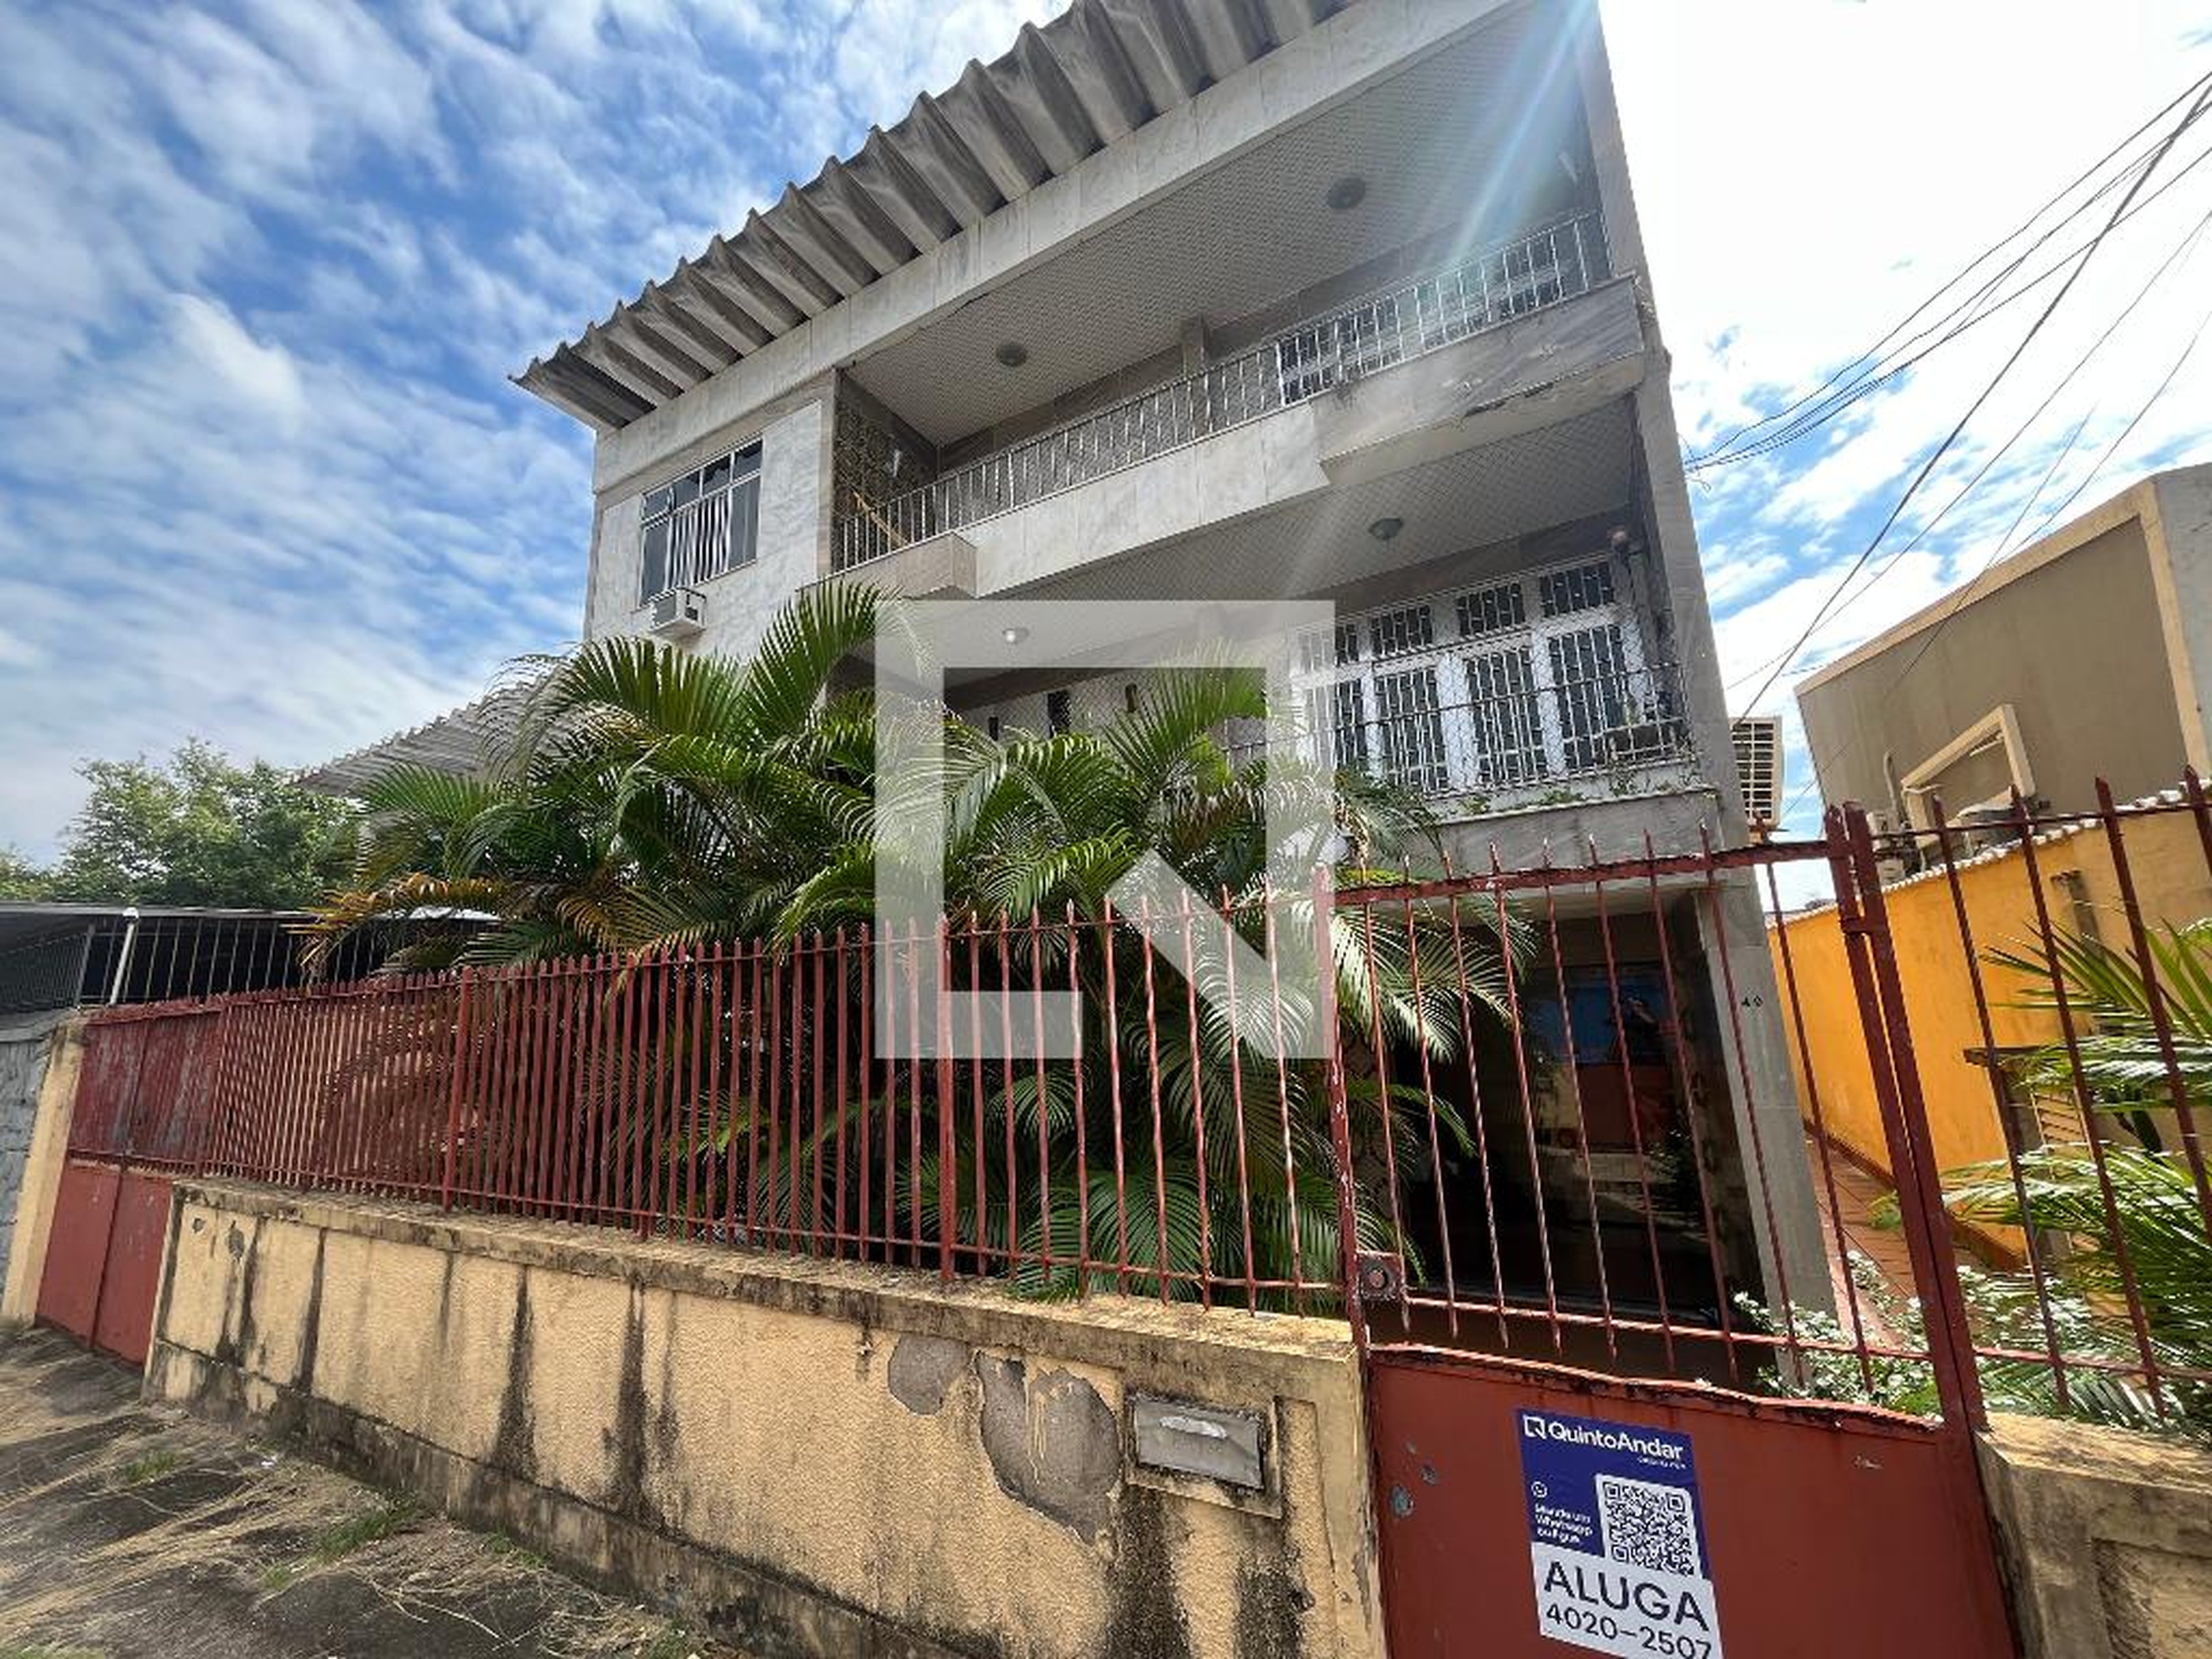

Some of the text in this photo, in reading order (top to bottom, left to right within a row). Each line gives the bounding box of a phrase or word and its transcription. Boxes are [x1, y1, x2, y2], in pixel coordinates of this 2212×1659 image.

[1548, 1422, 1683, 1460] QuintoAndar
[1544, 1562, 1709, 1631] ALUGA
[1547, 1605, 1711, 1659] 4020-2507
